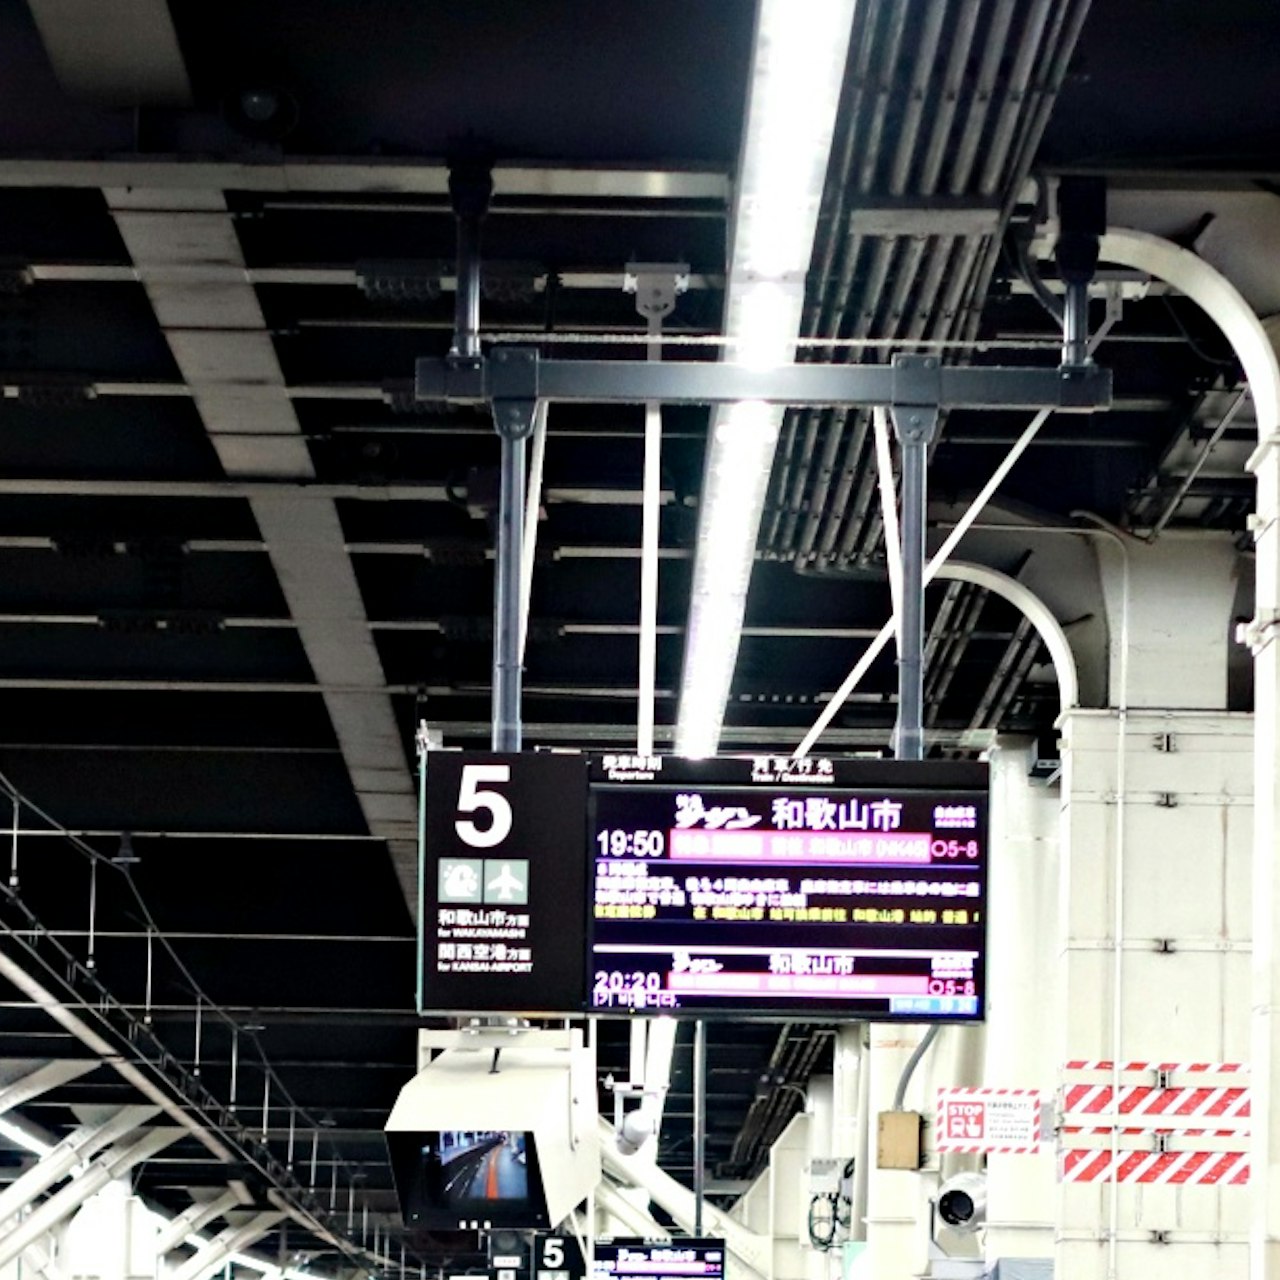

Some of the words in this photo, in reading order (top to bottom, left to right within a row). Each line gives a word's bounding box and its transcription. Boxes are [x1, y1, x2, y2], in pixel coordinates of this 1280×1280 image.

[608, 771, 655, 782] Departure
[455, 765, 512, 848] 5
[772, 798, 903, 831] 和歌山市
[597, 830, 664, 856] 19:50
[438, 909, 530, 927] 和歌山市方面
[437, 927, 452, 938] for
[437, 943, 532, 961] 関西空港方面
[437, 961, 451, 972] for
[594, 971, 660, 990] 20:20
[949, 1104, 983, 1117] STOP
[543, 1239, 565, 1268] 5
